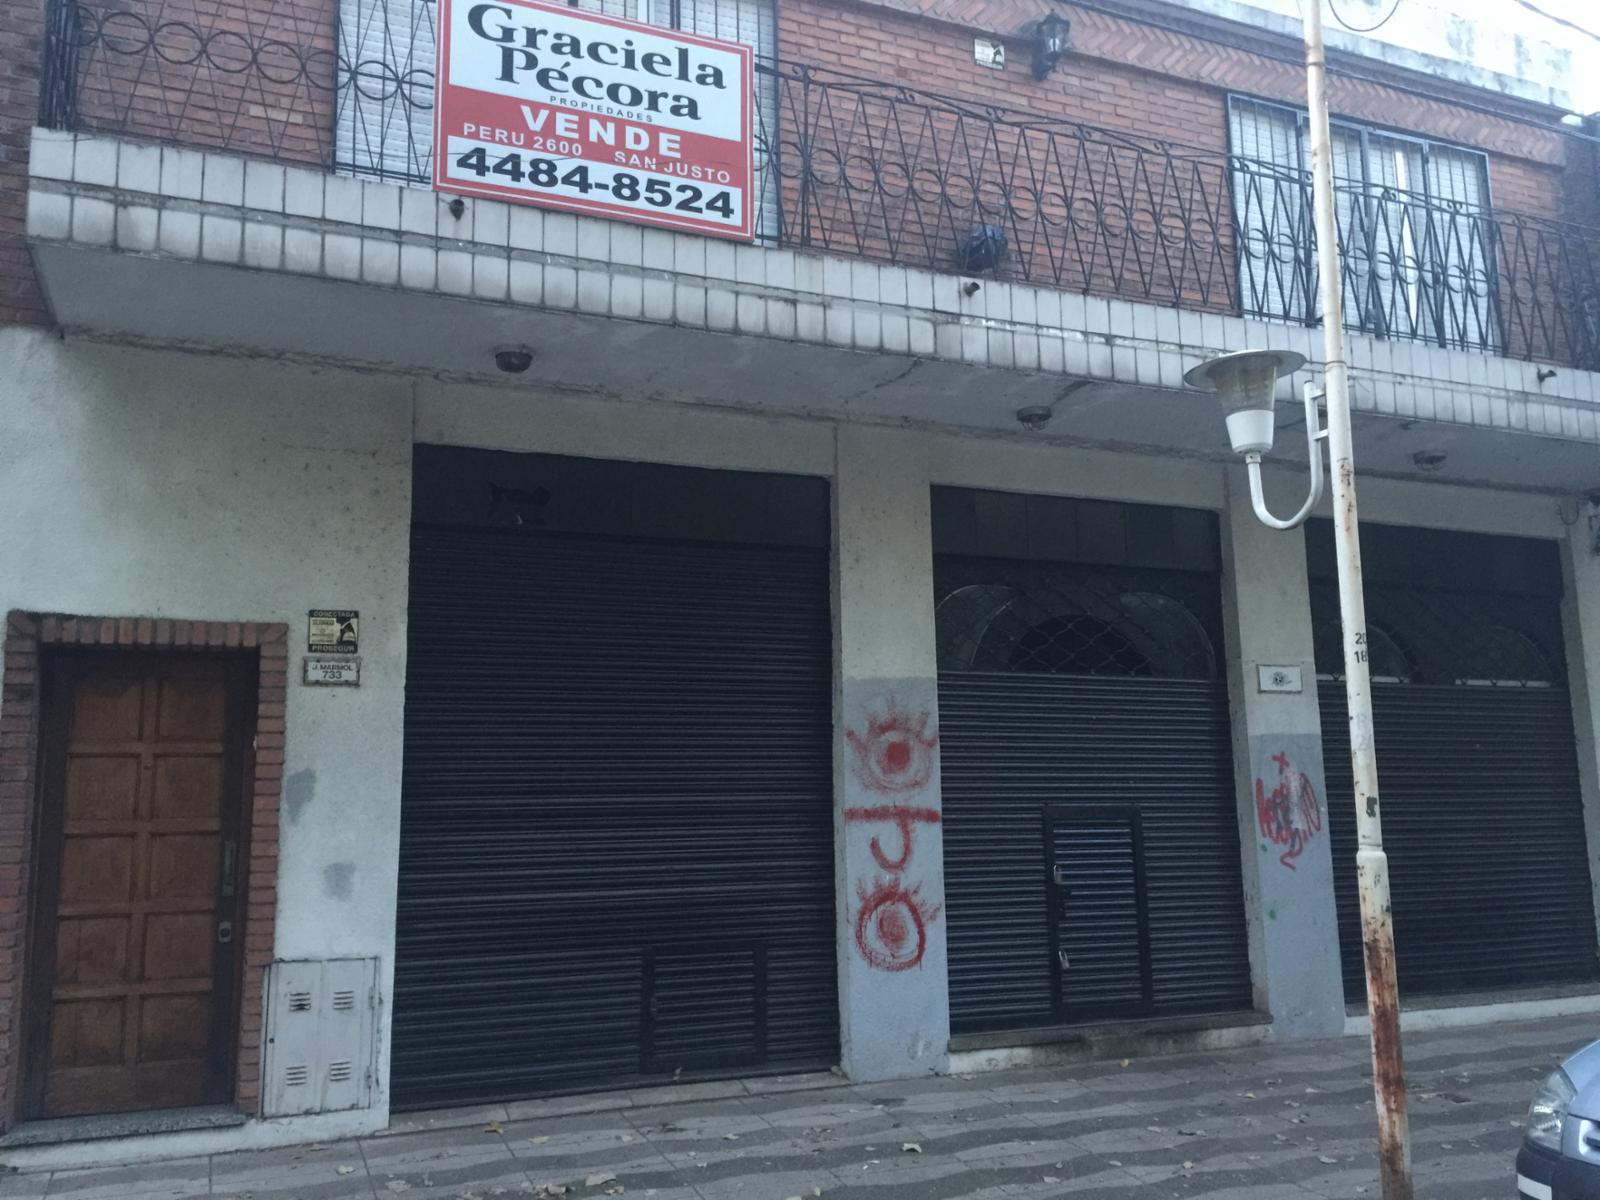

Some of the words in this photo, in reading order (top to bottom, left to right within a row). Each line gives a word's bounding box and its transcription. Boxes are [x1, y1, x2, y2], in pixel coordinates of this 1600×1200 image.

[467, 3, 727, 90] Graciela
[495, 43, 702, 121] Pécora
[549, 95, 654, 123] PROPIEDADES
[463, 122, 525, 146] PERU
[533, 136, 583, 156] 2600
[520, 104, 682, 159] VENDE
[456, 146, 735, 219] 4484-8524
[614, 151, 657, 170] SAN
[664, 161, 731, 184] JUSTO
[322, 670, 343, 680] 733
